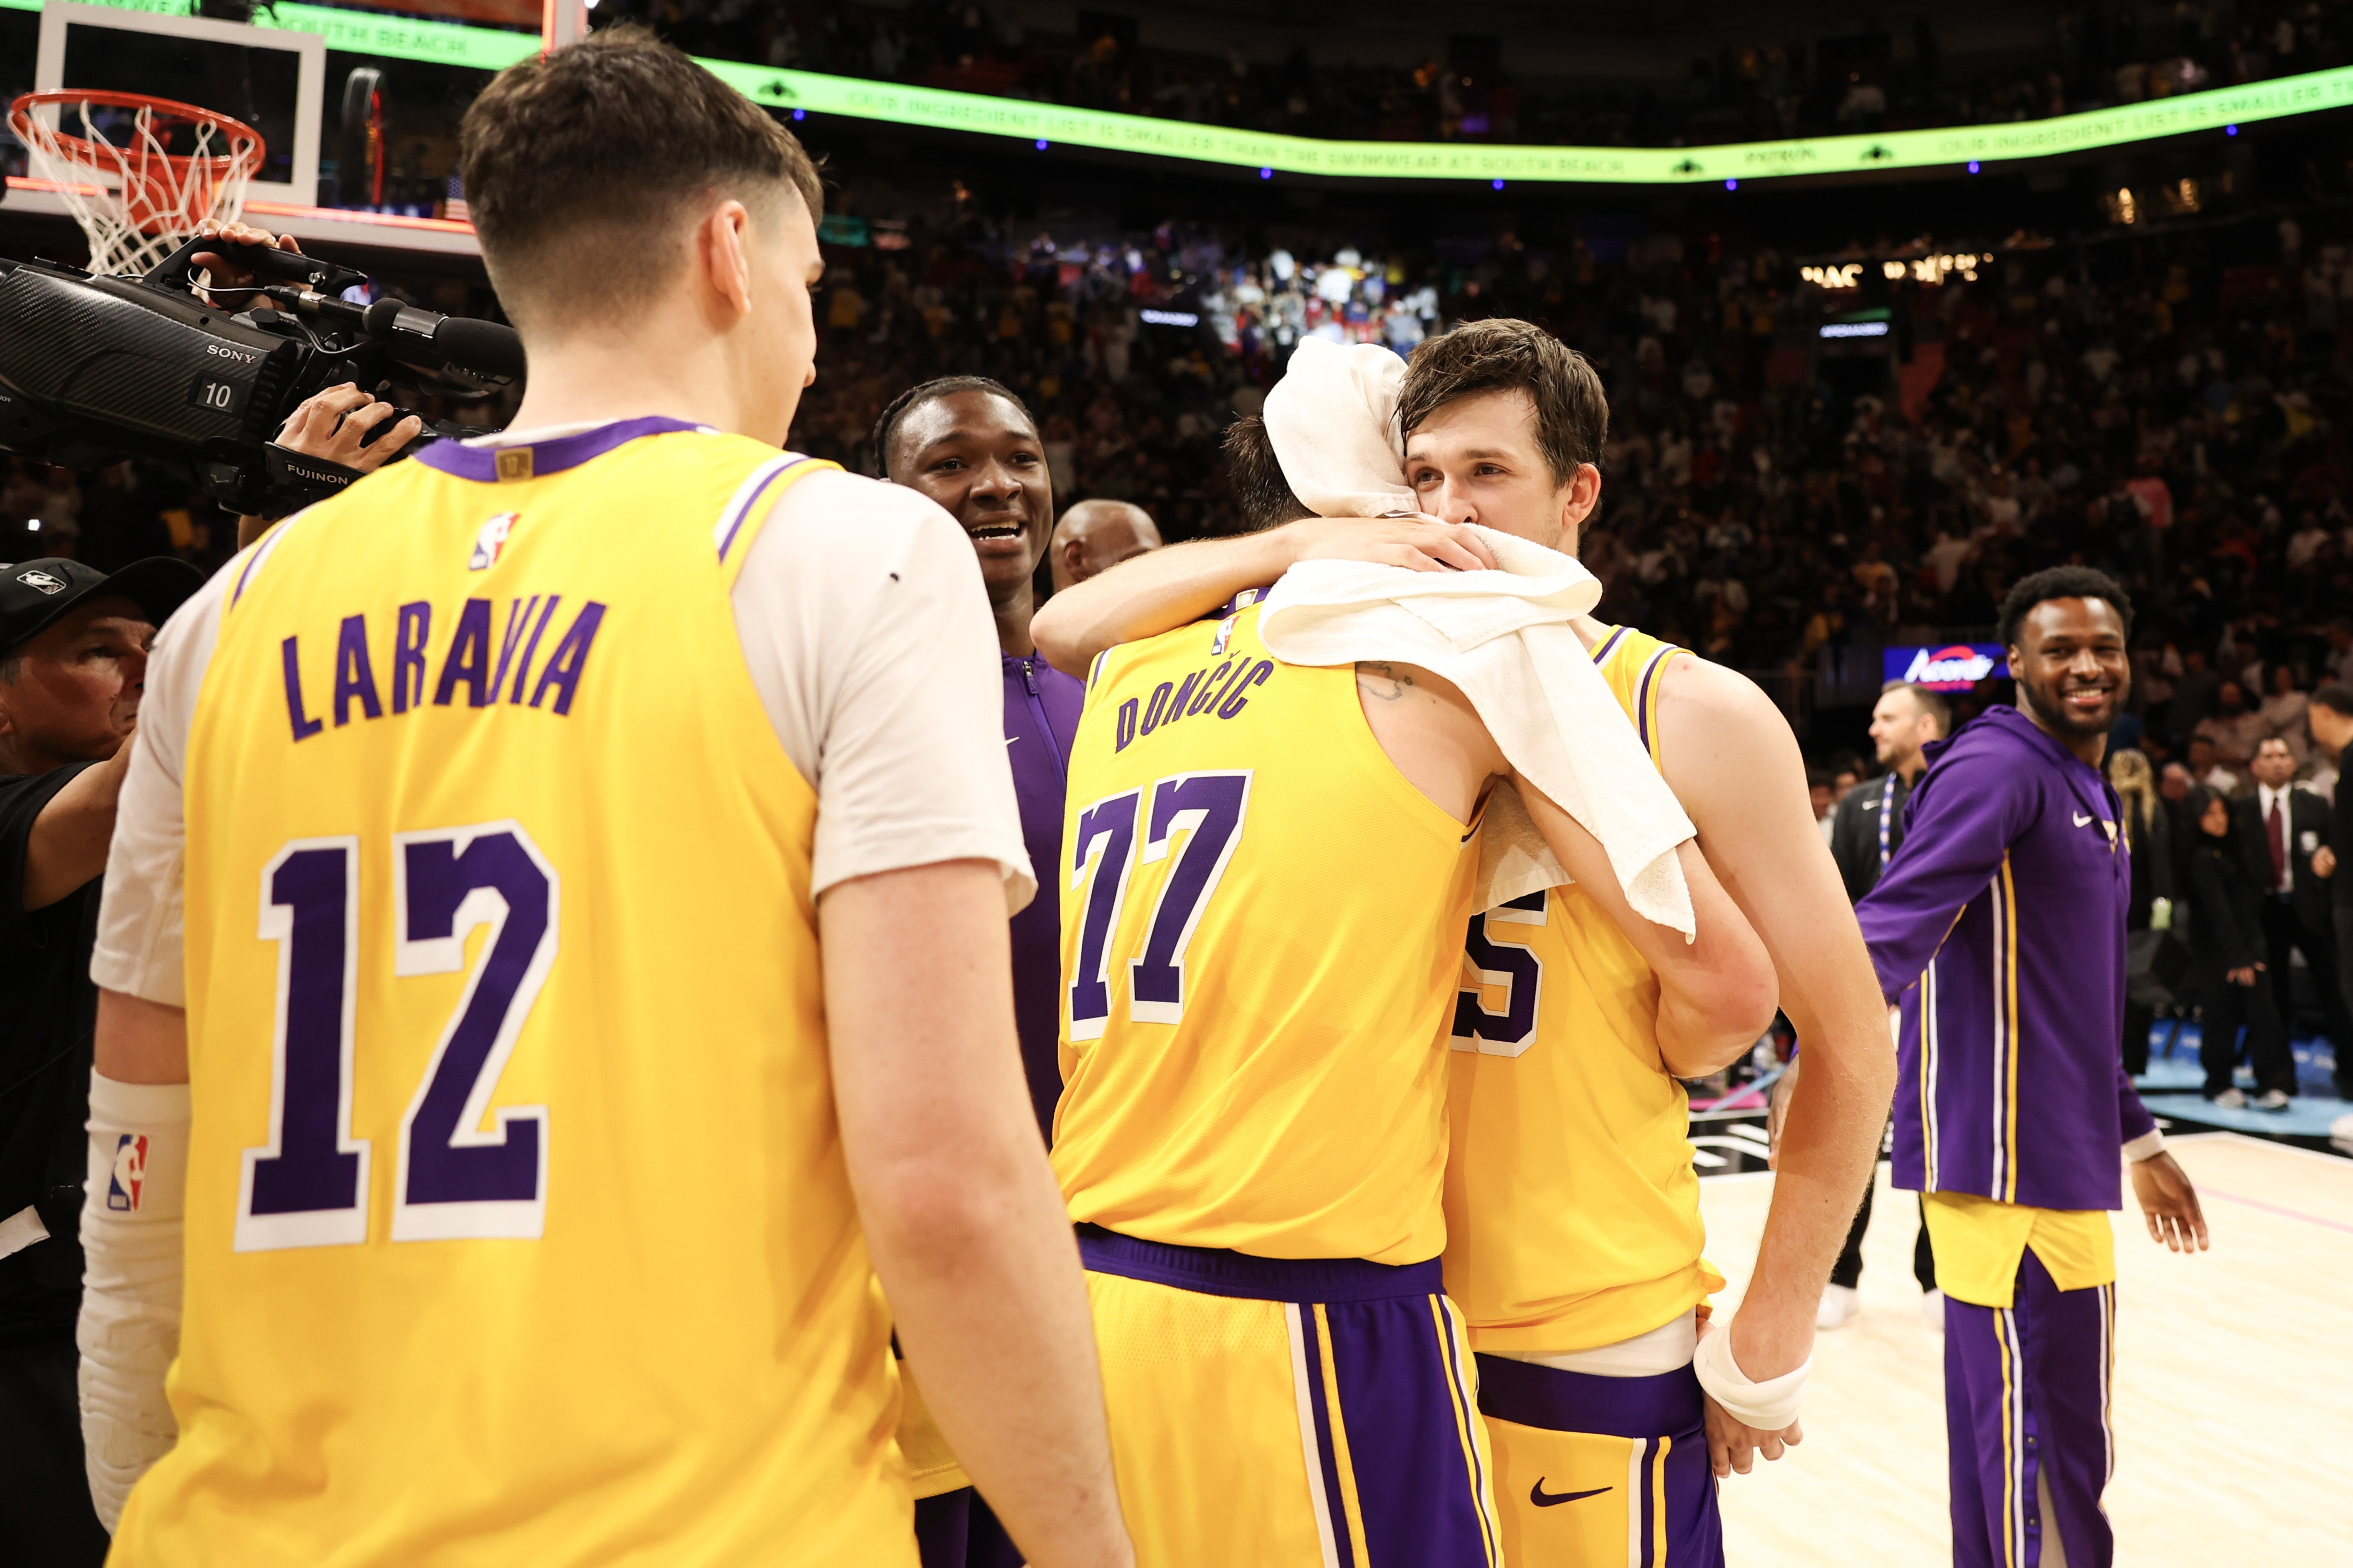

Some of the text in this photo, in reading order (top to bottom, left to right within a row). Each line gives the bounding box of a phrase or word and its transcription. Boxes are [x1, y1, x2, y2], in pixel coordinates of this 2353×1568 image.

[206, 383, 231, 408] 10
[207, 345, 257, 364] SONY
[288, 464, 348, 485] FUJINON
[282, 594, 609, 743] LARAVIA
[1069, 768, 1255, 1043] 77
[233, 817, 560, 1252] 12
